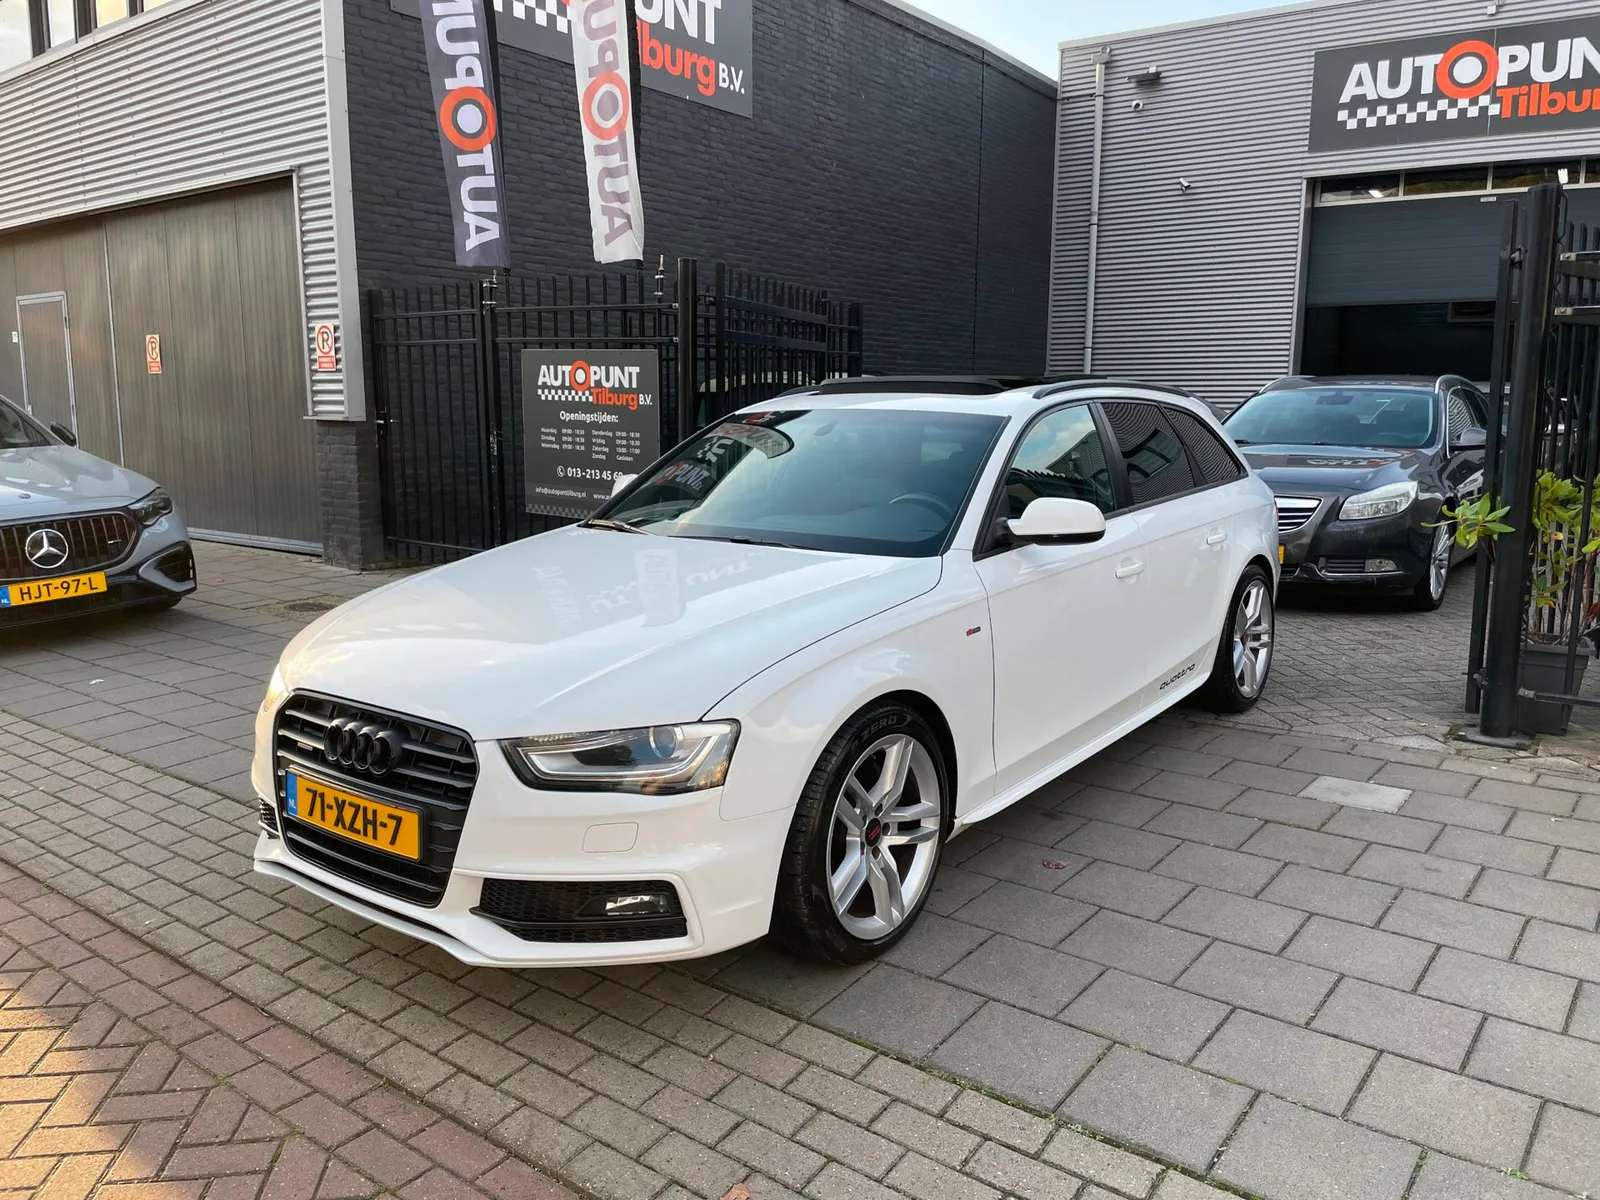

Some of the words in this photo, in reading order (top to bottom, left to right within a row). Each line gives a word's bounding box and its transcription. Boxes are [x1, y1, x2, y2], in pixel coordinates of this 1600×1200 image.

[719, 62, 744, 94] B.V.
[538, 360, 640, 392] AUTOPUNT
[590, 388, 638, 411] Tilburg
[639, 394, 653, 406] B.V.
[560, 411, 619, 423] Openingstijden:
[602, 470, 611, 480] 45
[19, 577, 98, 601] HJT-97-L
[306, 787, 402, 846] 71-XZH-7
